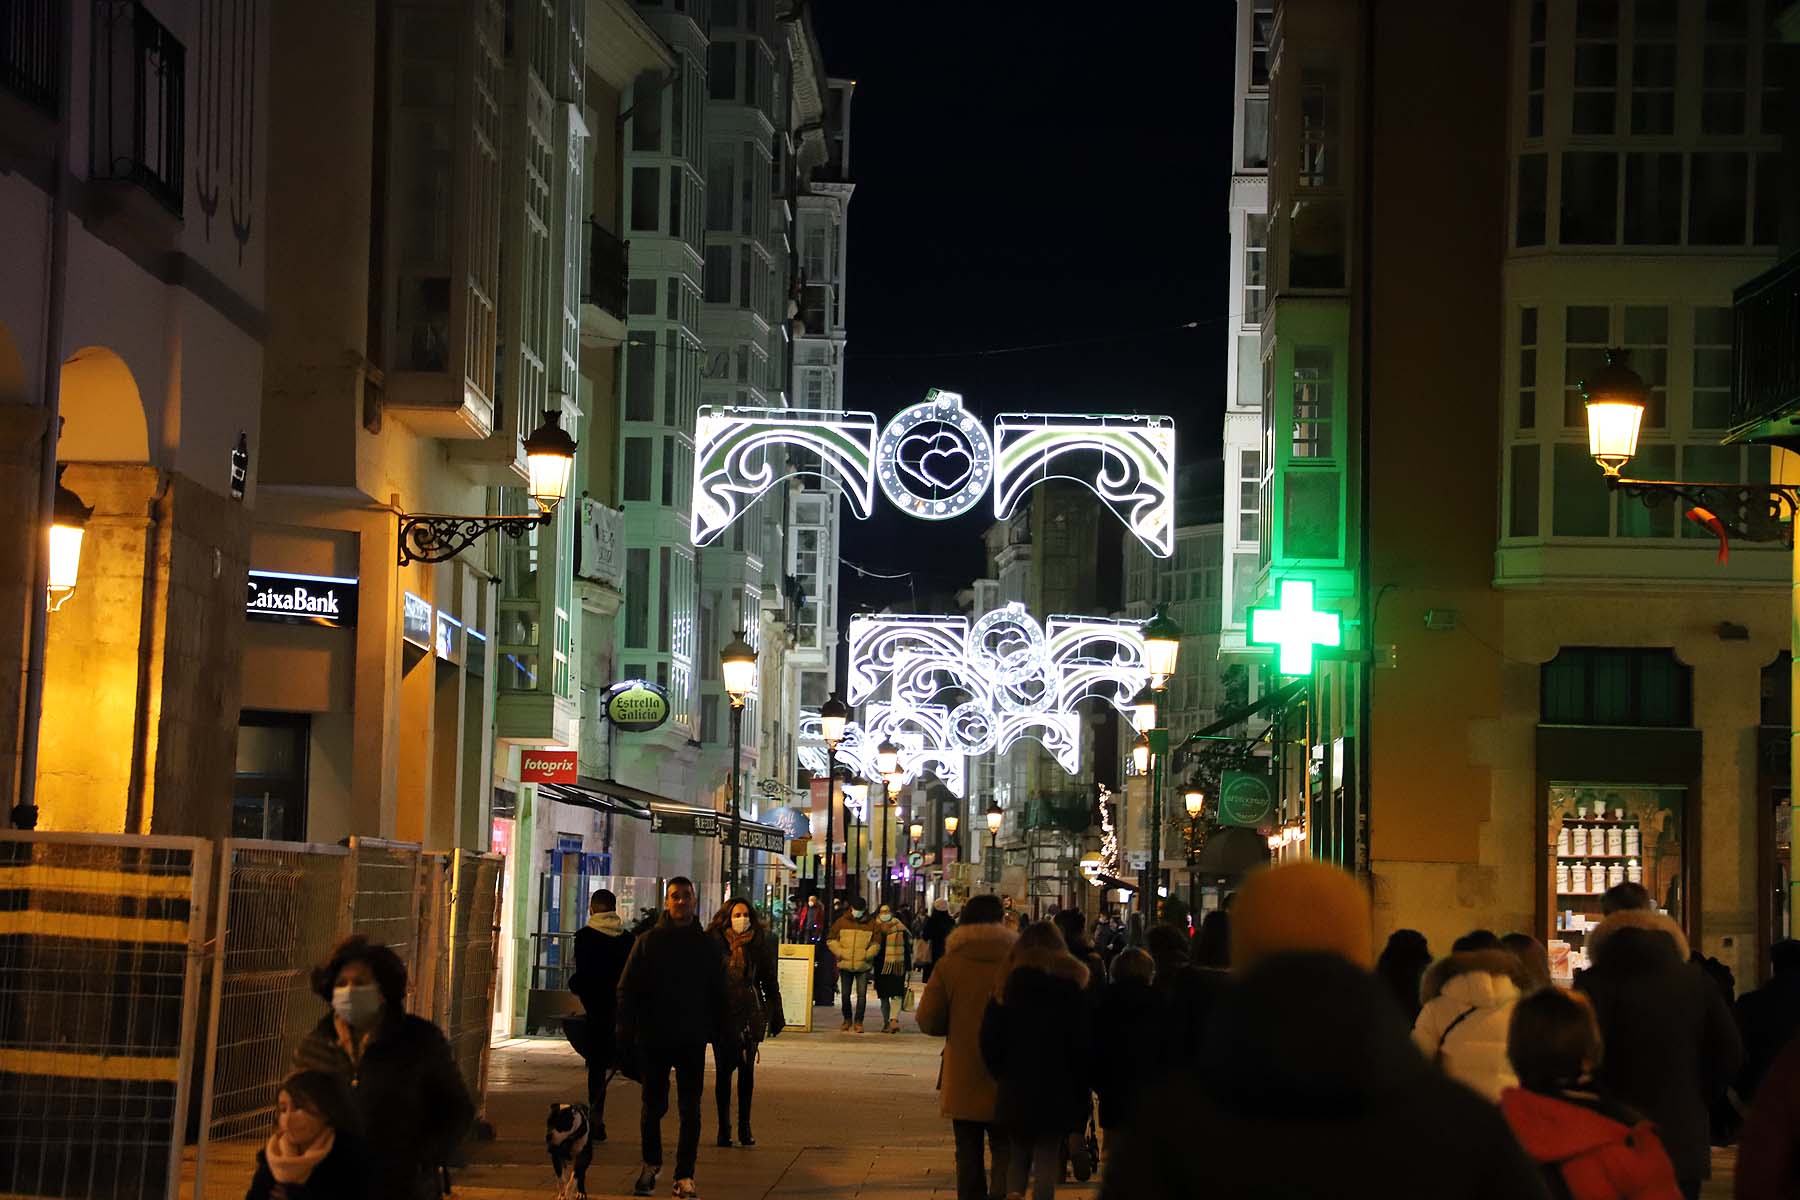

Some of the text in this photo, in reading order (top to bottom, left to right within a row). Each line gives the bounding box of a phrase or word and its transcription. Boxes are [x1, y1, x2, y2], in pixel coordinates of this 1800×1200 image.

[247, 582, 339, 613] CaixaBank
[616, 697, 660, 708] Estrella
[618, 709, 657, 720] Galicia
[524, 758, 573, 772] fotoprix
